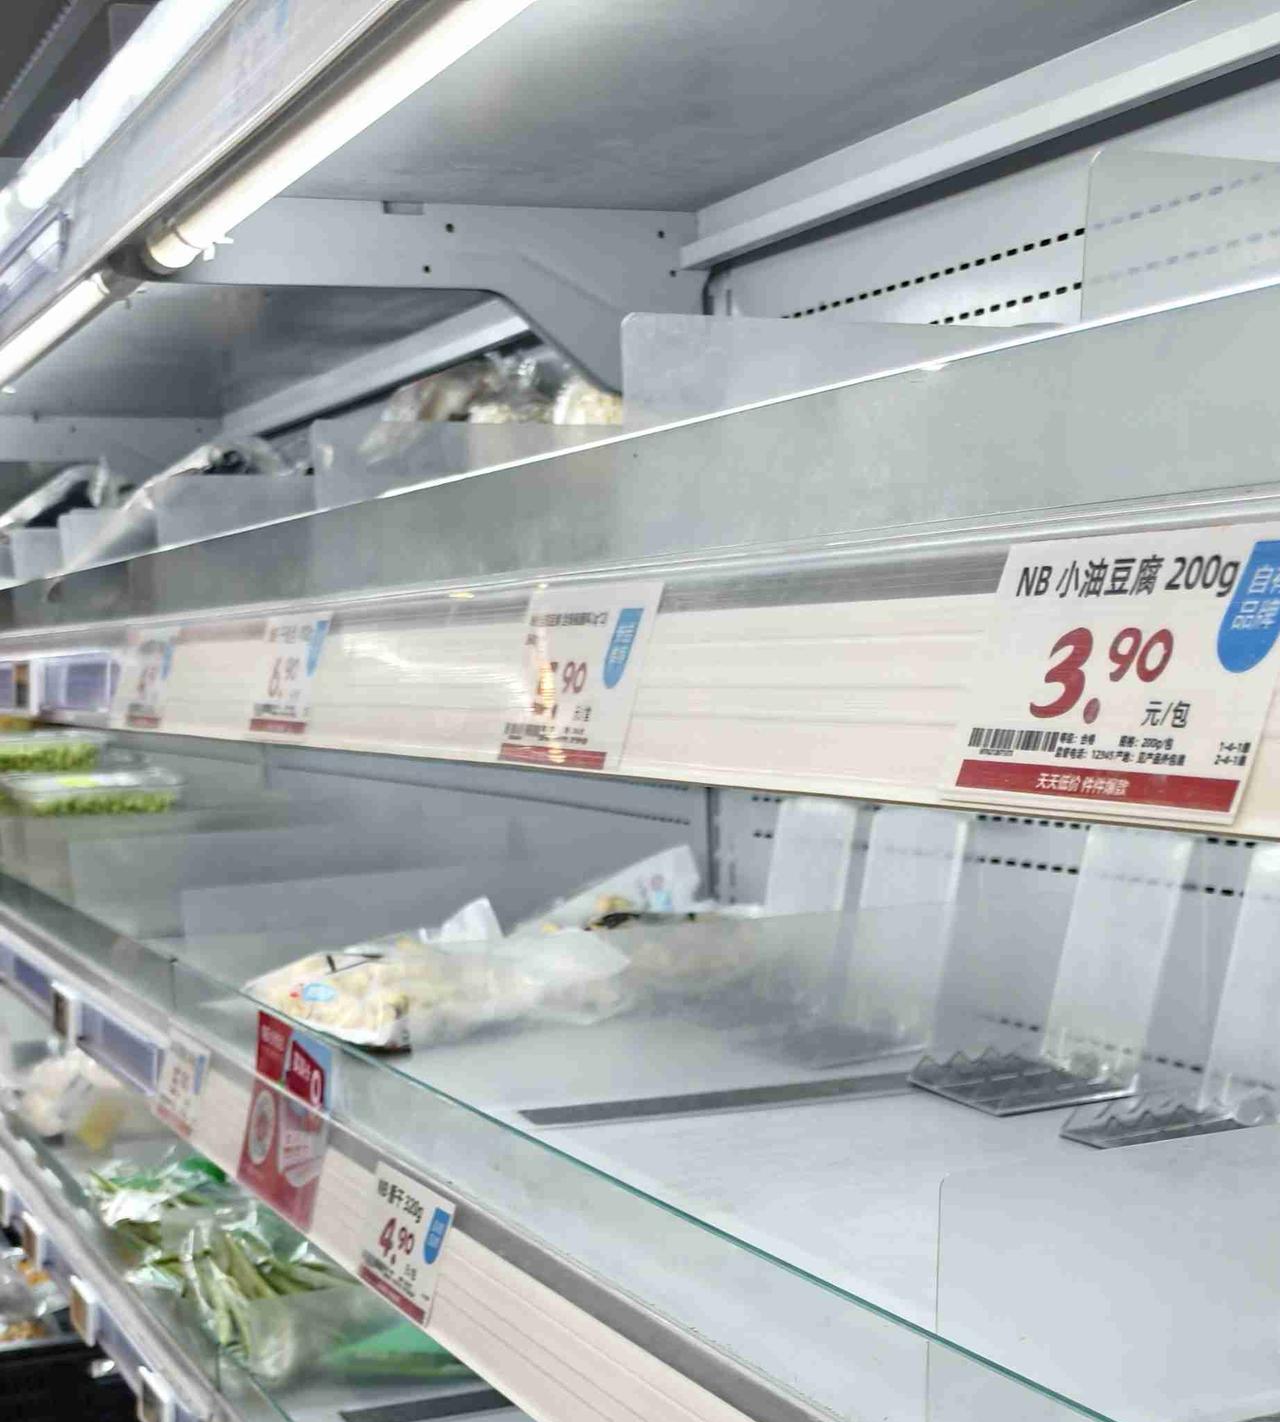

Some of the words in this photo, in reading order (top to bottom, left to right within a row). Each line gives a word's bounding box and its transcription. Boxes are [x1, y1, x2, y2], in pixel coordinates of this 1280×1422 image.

[1016, 566, 1052, 597] NB
[1056, 554, 1164, 599] 小油豆腐
[1165, 555, 1240, 598] 200g
[1030, 627, 1174, 724] 3.90
[1141, 700, 1191, 729] 元/包
[378, 1217, 415, 1265] 4.90
